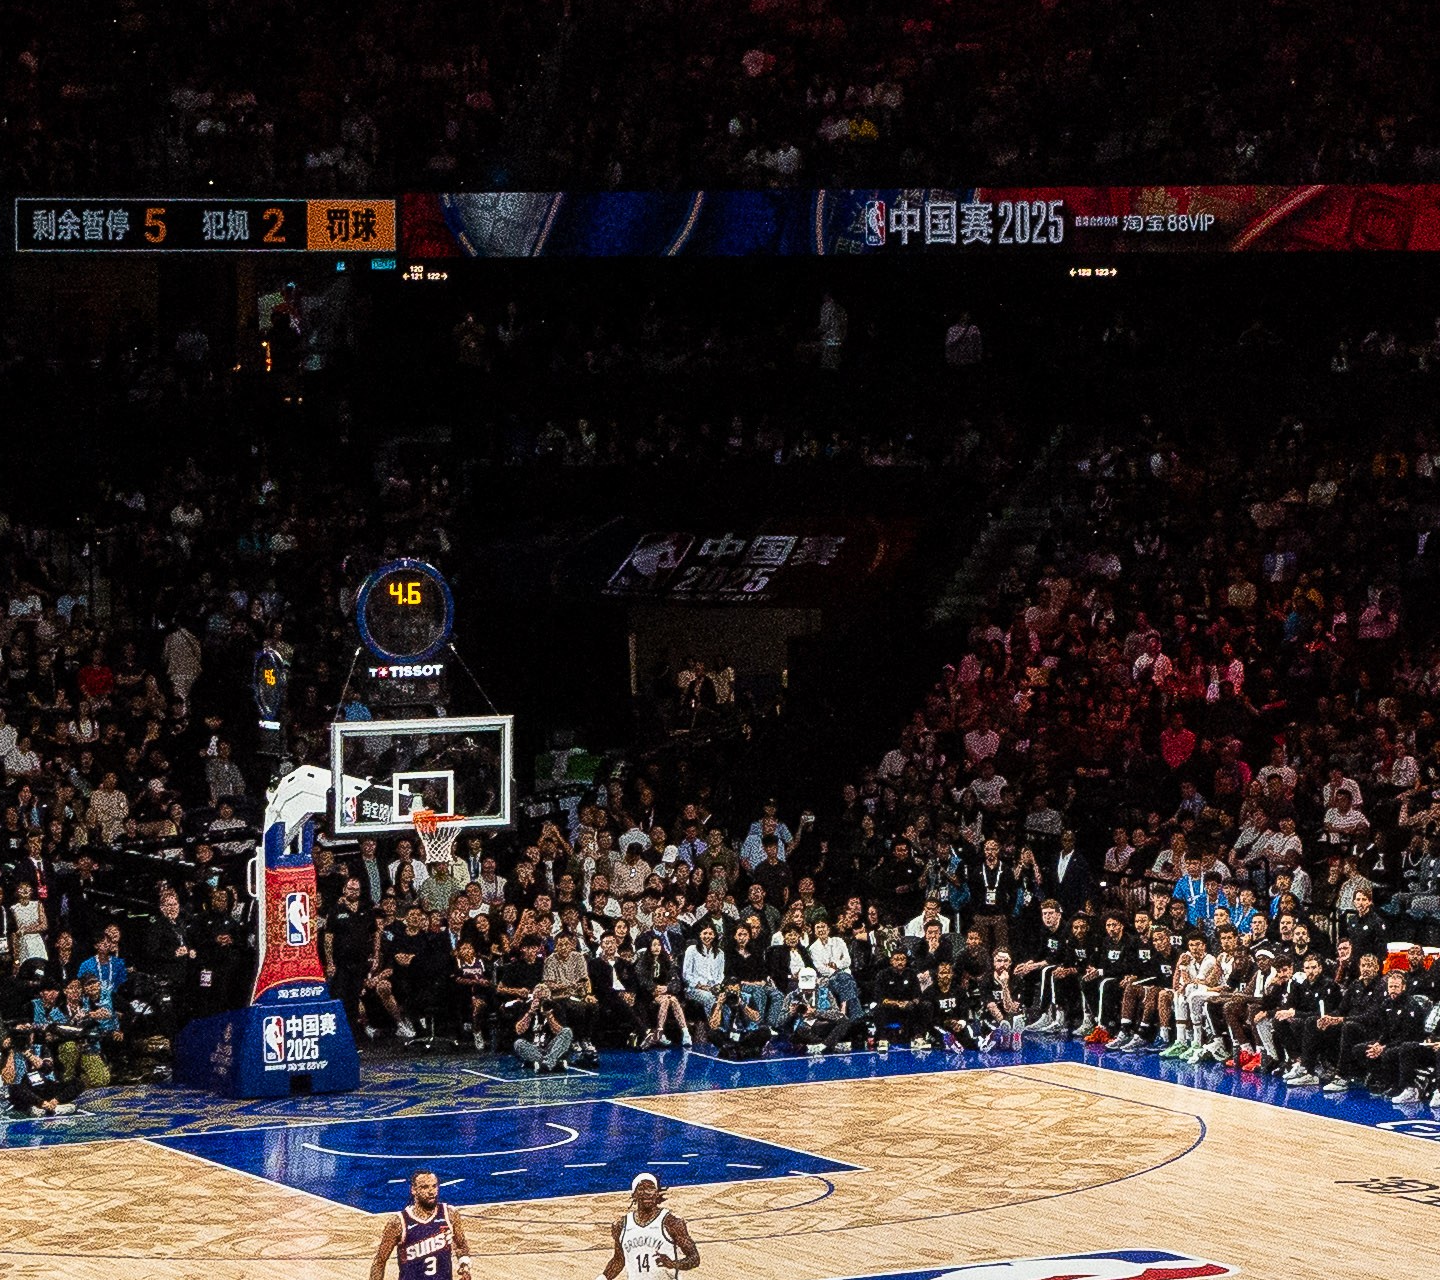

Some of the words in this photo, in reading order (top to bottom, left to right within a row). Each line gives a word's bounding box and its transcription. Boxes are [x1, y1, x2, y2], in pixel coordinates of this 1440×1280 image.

[32, 208, 130, 241] 剩余暂停
[144, 208, 166, 242] 5
[202, 209, 248, 241] 犯规
[263, 208, 285, 242] 2
[327, 208, 376, 240] 罚球
[1123, 213, 1214, 232] 淘宝88VIP
[389, 582, 422, 605] 4.6
[390, 664, 444, 678] TISSOT
[286, 1013, 336, 1038] 中国赛
[287, 1038, 319, 1061] 2025
[406, 1232, 455, 1261] SUNS
[624, 1237, 664, 1253] BROOKLYN
[424, 1256, 438, 1276] 3
[636, 1253, 651, 1273] 14
